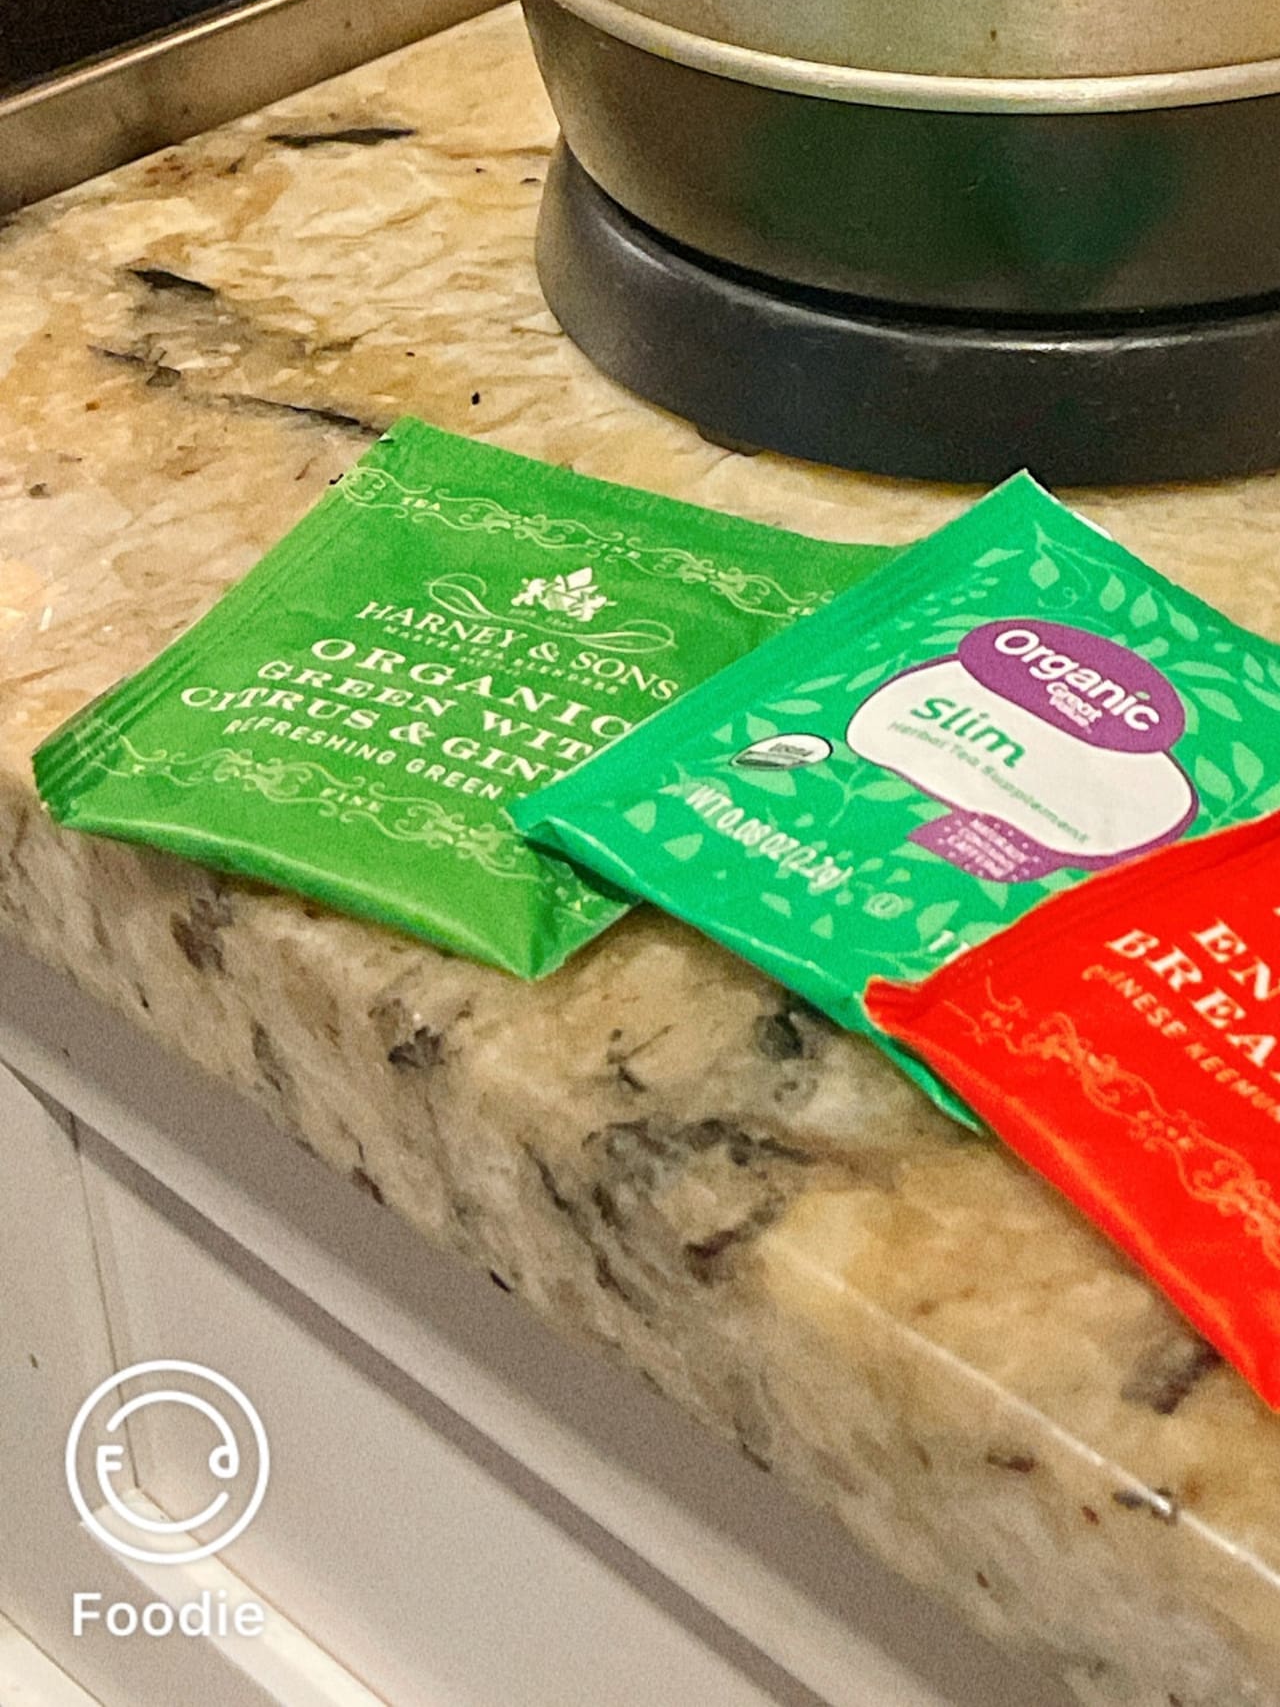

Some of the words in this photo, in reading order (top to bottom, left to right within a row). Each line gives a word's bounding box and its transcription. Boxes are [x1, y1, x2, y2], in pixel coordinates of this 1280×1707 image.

[311, 637, 633, 740] ORGANIC
[355, 600, 528, 649] HARNEY
[527, 641, 561, 663] &
[569, 650, 680, 701] SONS
[993, 627, 1160, 732] Organic
[180, 686, 382, 731] CITRUS
[388, 720, 436, 747] &
[441, 736, 567, 783] GIN
[221, 715, 397, 766] REFRESHING
[405, 757, 504, 801] GREEN
[257, 660, 459, 717] GREEN
[482, 709, 594, 762] WIT
